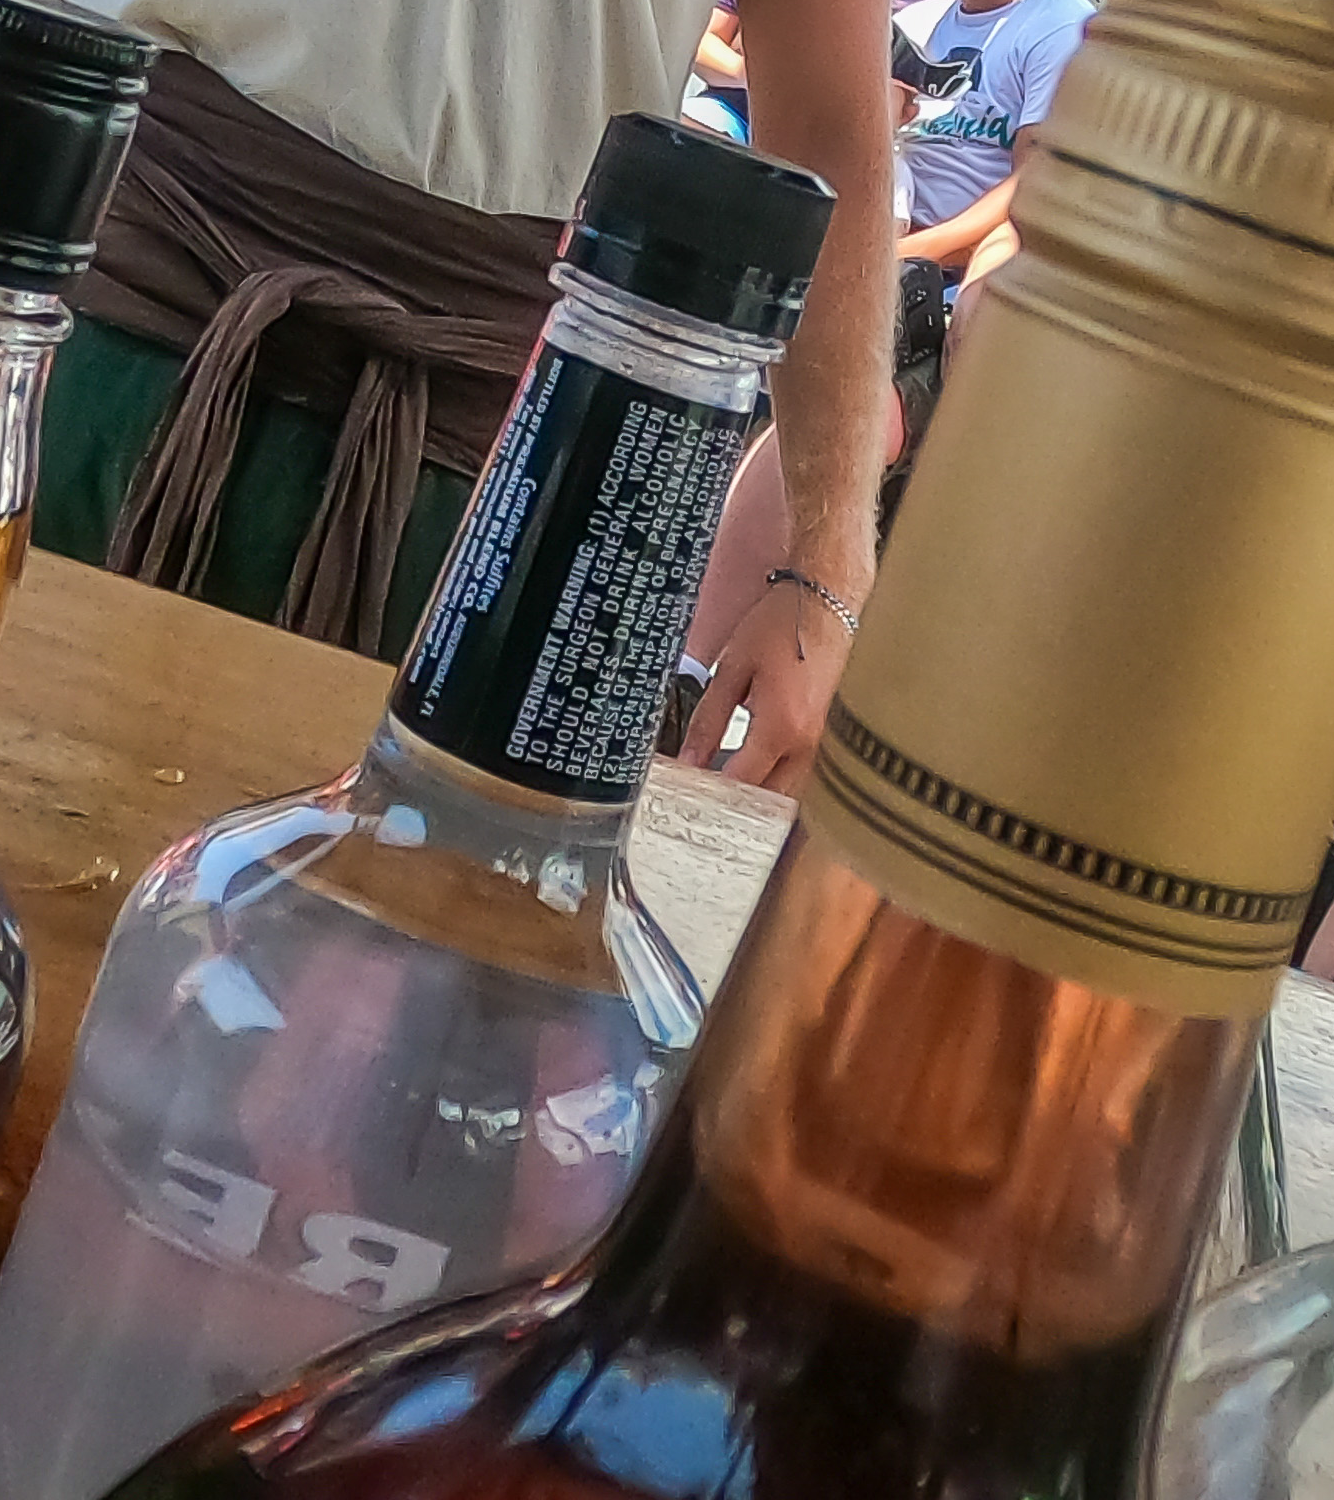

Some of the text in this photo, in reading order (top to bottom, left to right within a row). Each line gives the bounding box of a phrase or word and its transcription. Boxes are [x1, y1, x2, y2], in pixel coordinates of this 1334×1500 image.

[475, 477, 537, 613] Contains Sulfites
[505, 401, 648, 758] GOVERNMENT WARNING: (1) ACCORDING
[524, 740, 549, 764] TO
[537, 694, 566, 729] THE
[554, 592, 602, 686] SURGEON
[628, 406, 669, 481] WOMEN
[651, 564, 668, 588] OF
[660, 508, 689, 562] BIRTH
[546, 413, 686, 772] SHOULD NOT DRINK ALCOHOLIC
[564, 655, 620, 776] BEVERAGES
[613, 559, 654, 641] DURING
[647, 418, 703, 545] PREGNANCY
[634, 590, 662, 633] RISK
[601, 755, 625, 782] (2)
[615, 592, 679, 740] CONSUMPTION
[612, 673, 631, 697] OF
[621, 636, 645, 668] THE
[583, 700, 623, 780] BECAUSE
